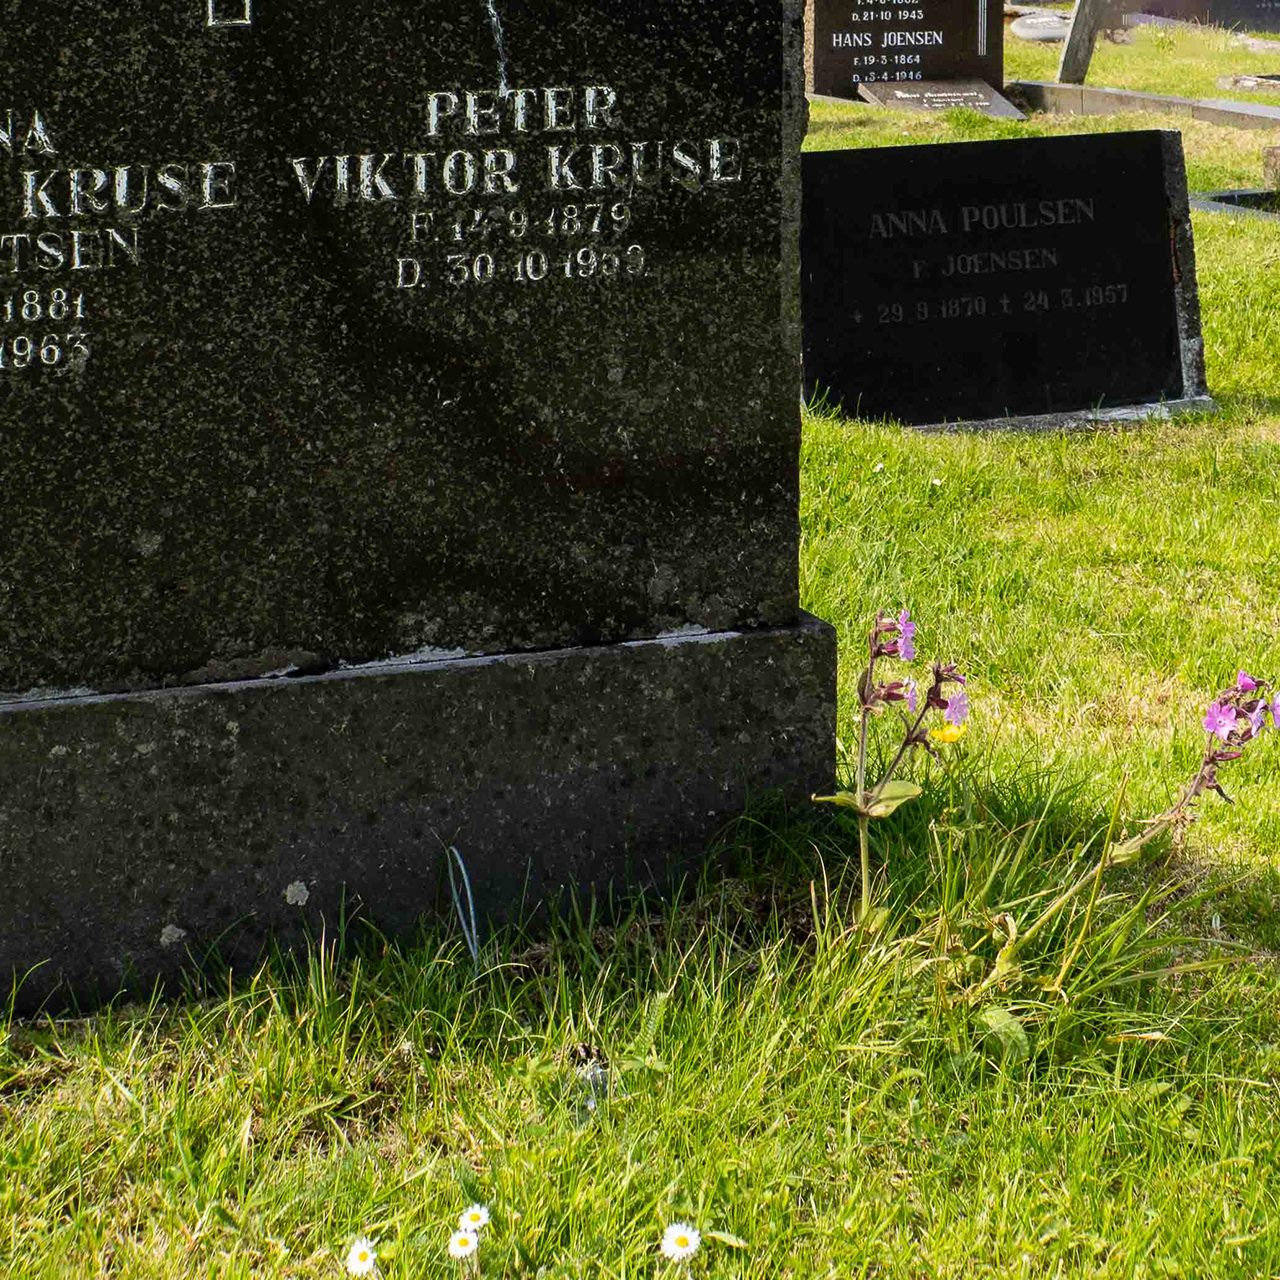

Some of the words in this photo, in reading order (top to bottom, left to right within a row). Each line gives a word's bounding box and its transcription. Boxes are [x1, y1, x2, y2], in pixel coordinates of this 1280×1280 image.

[832, 33, 872, 47] HANS
[881, 31, 943, 48] JOENSEN
[426, 86, 618, 136] PETER
[22, 161, 239, 221] KRUSE
[292, 148, 520, 203] VIKTOR
[546, 138, 744, 192] KRUSE
[870, 208, 948, 238] ANNA
[961, 198, 1096, 232] POULSEN
[941, 248, 1059, 277] JOENSEN
